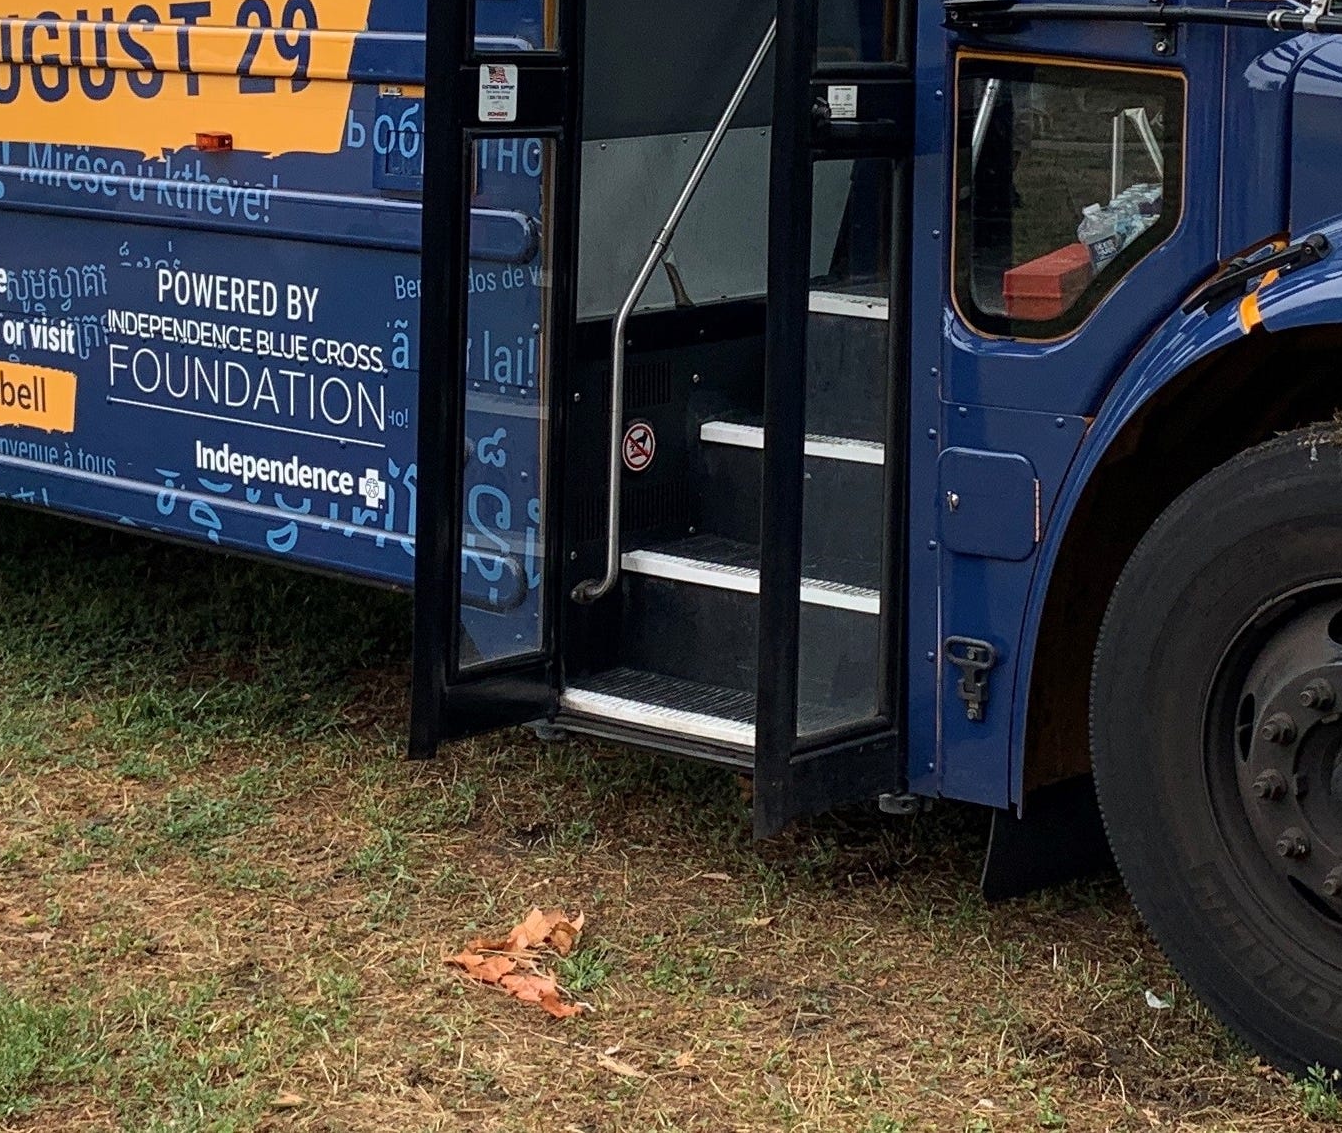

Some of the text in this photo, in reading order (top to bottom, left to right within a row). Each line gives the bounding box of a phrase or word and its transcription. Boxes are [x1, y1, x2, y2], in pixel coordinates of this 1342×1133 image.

[28, 144, 122, 197] Mirëse
[155, 161, 279, 224] ktheve!
[158, 268, 319, 323] POWERED BY
[3, 320, 25, 346] or
[30, 318, 76, 354] visit
[108, 309, 252, 353] INDEPENDENCE
[256, 330, 307, 362] BLUE
[109, 344, 386, 430] FOUNDATION
[78, 441, 117, 477] tous
[195, 440, 354, 497] Independence
